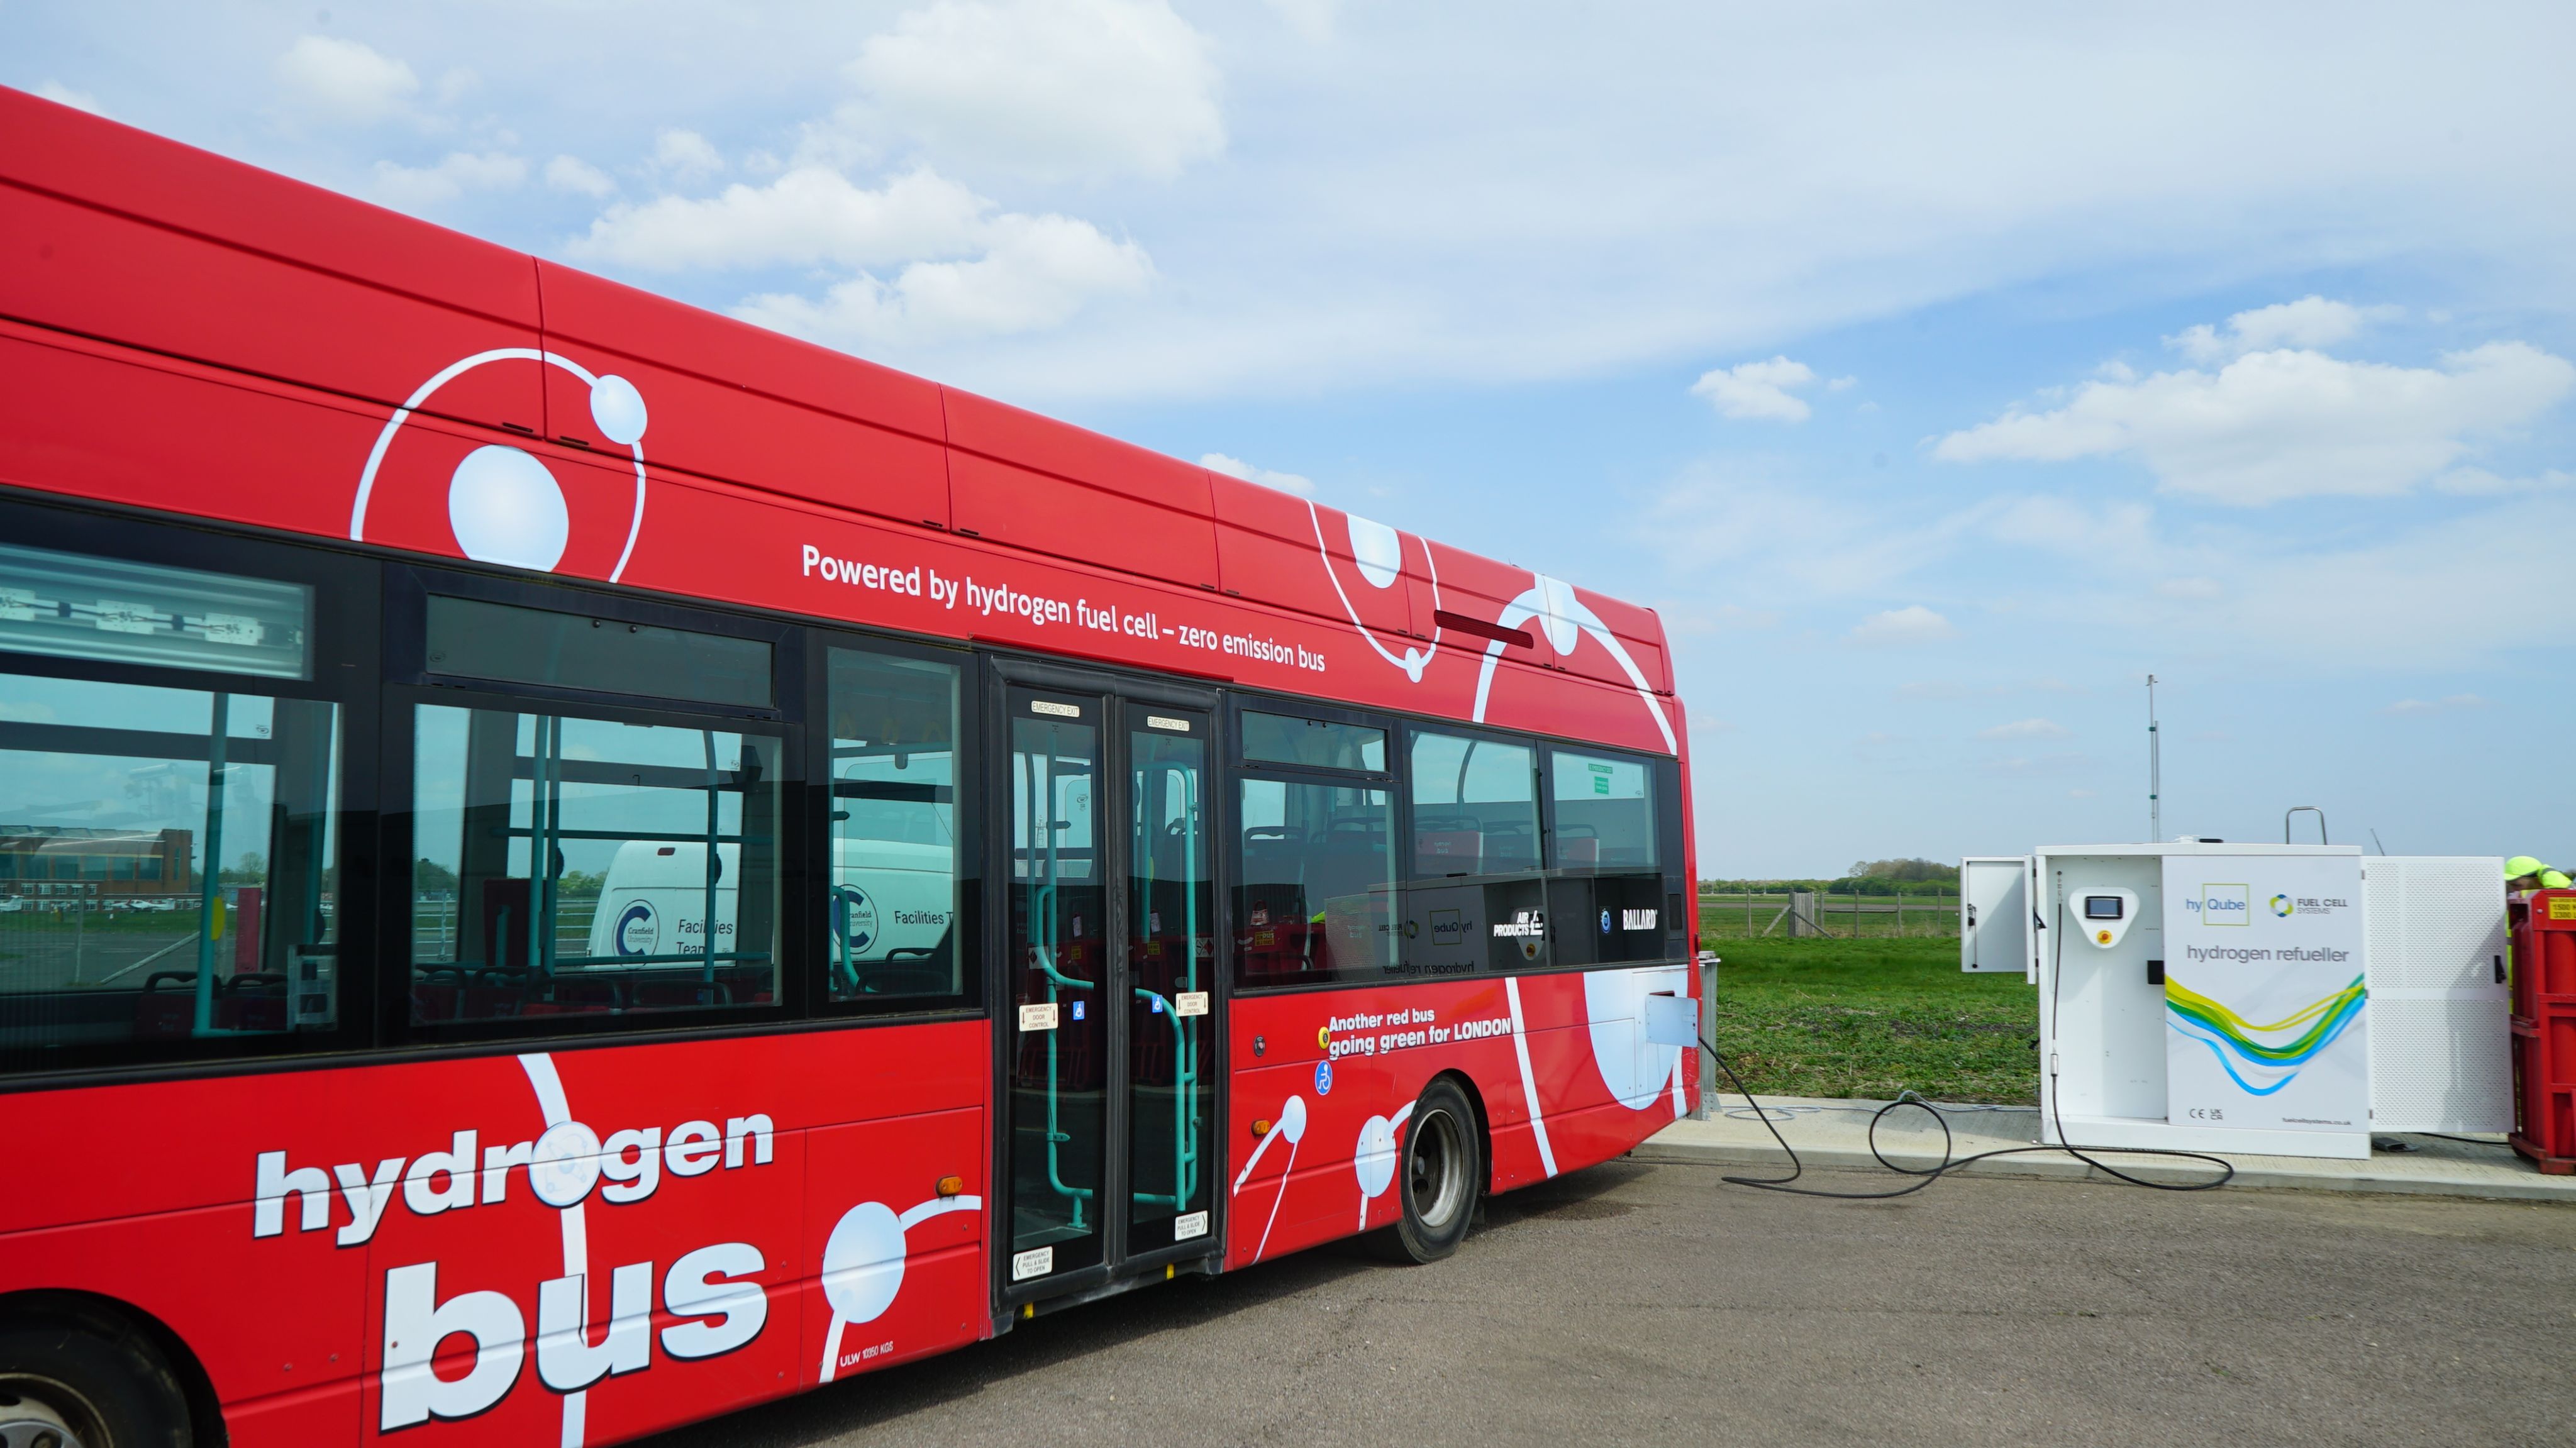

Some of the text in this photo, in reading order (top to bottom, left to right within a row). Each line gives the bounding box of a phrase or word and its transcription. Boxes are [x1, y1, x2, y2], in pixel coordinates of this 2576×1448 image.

[802, 544, 921, 597] Powered
[930, 569, 958, 609] by
[966, 576, 1070, 626] hydrogen
[1076, 599, 1119, 633] fuel
[1123, 612, 1158, 640] cell
[1179, 625, 1218, 650] zero
[1223, 633, 1294, 666] emission
[1298, 644, 1326, 672] bus
[1033, 702, 1079, 716] EMERGENCY EXIT
[1148, 717, 1189, 729] EMERGENCY EXIT
[2297, 898, 2348, 907] FUEL CELL
[894, 911, 944, 924] Facilities
[1516, 912, 1529, 924] AIR
[1623, 909, 1657, 931] BALLARD
[678, 919, 733, 934] Facilies
[1493, 924, 1530, 937] PRODUCTS
[2187, 945, 2349, 963] hydrogen refueller
[1328, 1009, 1435, 1032] Another red bus
[1328, 1017, 1512, 1061] going green for LONDON
[253, 1112, 775, 1248] hydrogen
[1178, 1215, 1199, 1224] EMERGENCY
[1023, 1251, 1050, 1261] EMERGENCY
[380, 1241, 769, 1434] bus
[840, 1351, 861, 1368] ULW
[880, 1340, 894, 1354] KGS
